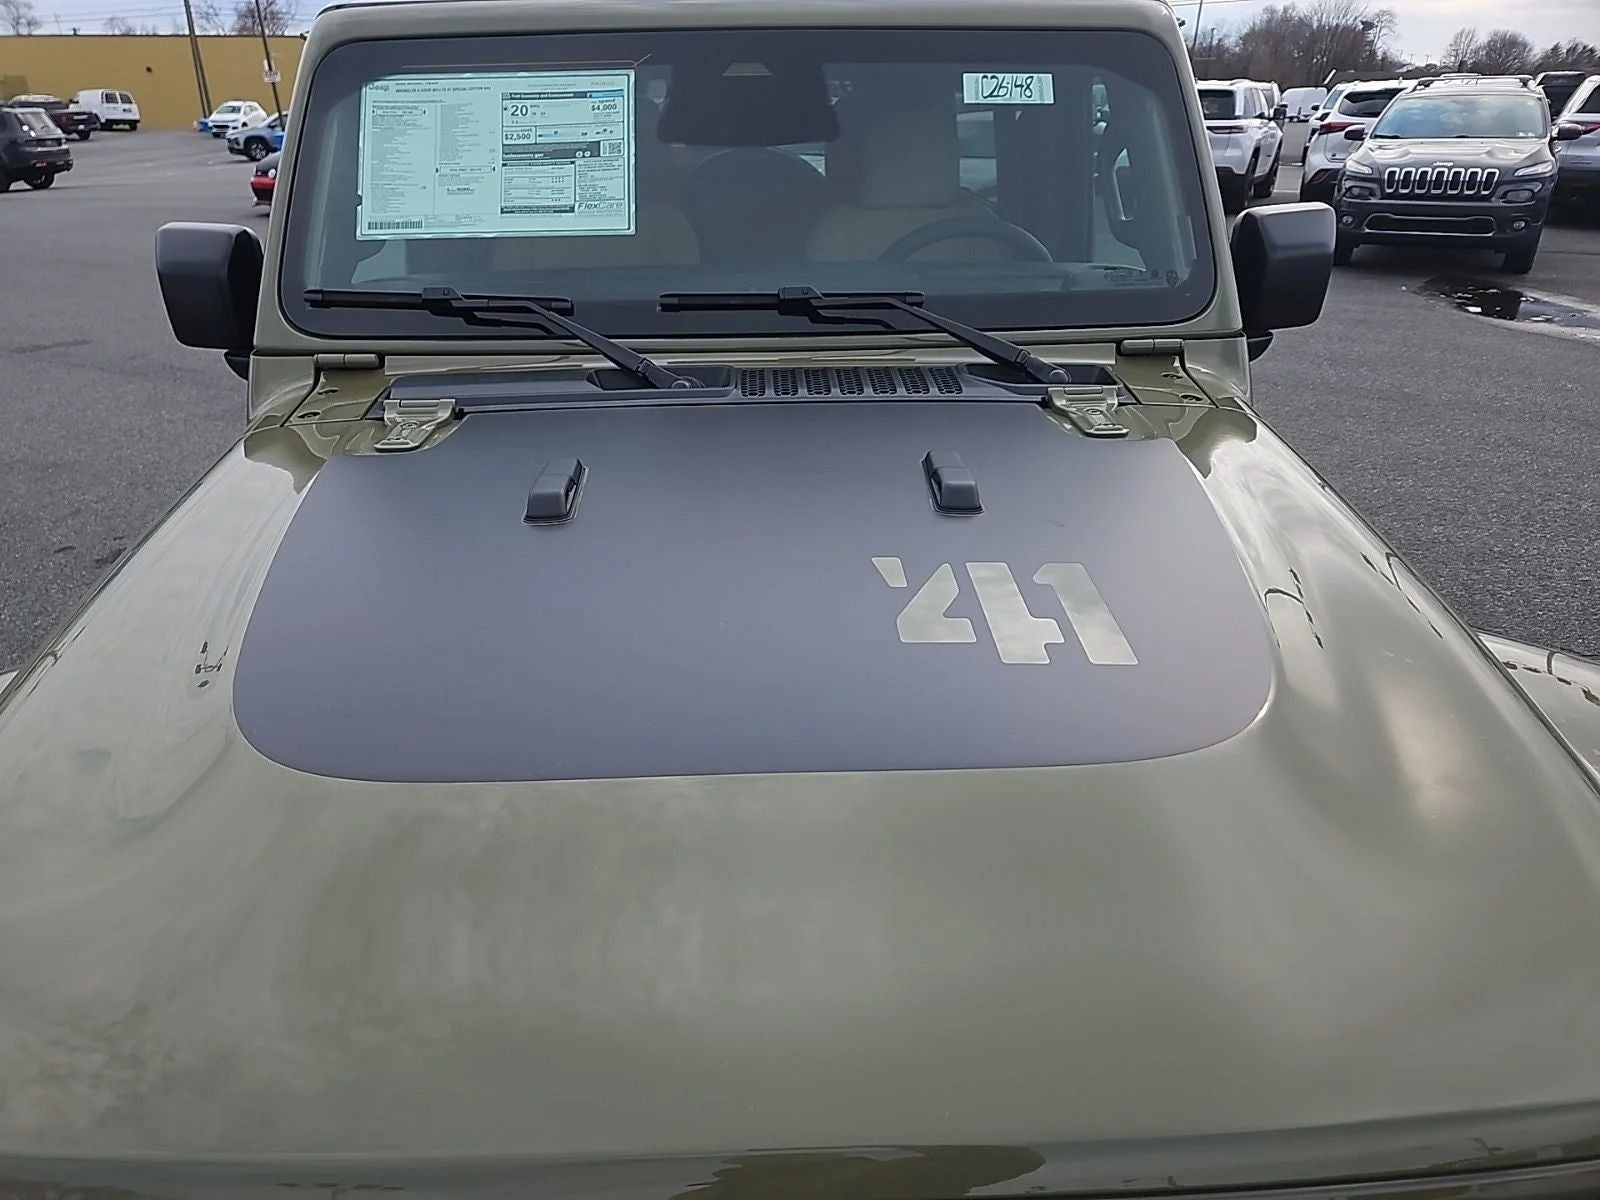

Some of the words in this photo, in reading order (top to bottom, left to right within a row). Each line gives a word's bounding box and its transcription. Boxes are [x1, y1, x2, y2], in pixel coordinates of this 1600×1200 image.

[510, 104, 529, 117] 20
[591, 103, 618, 112] $4,000
[504, 133, 531, 141] $2,500
[577, 201, 623, 210] FlexCare
